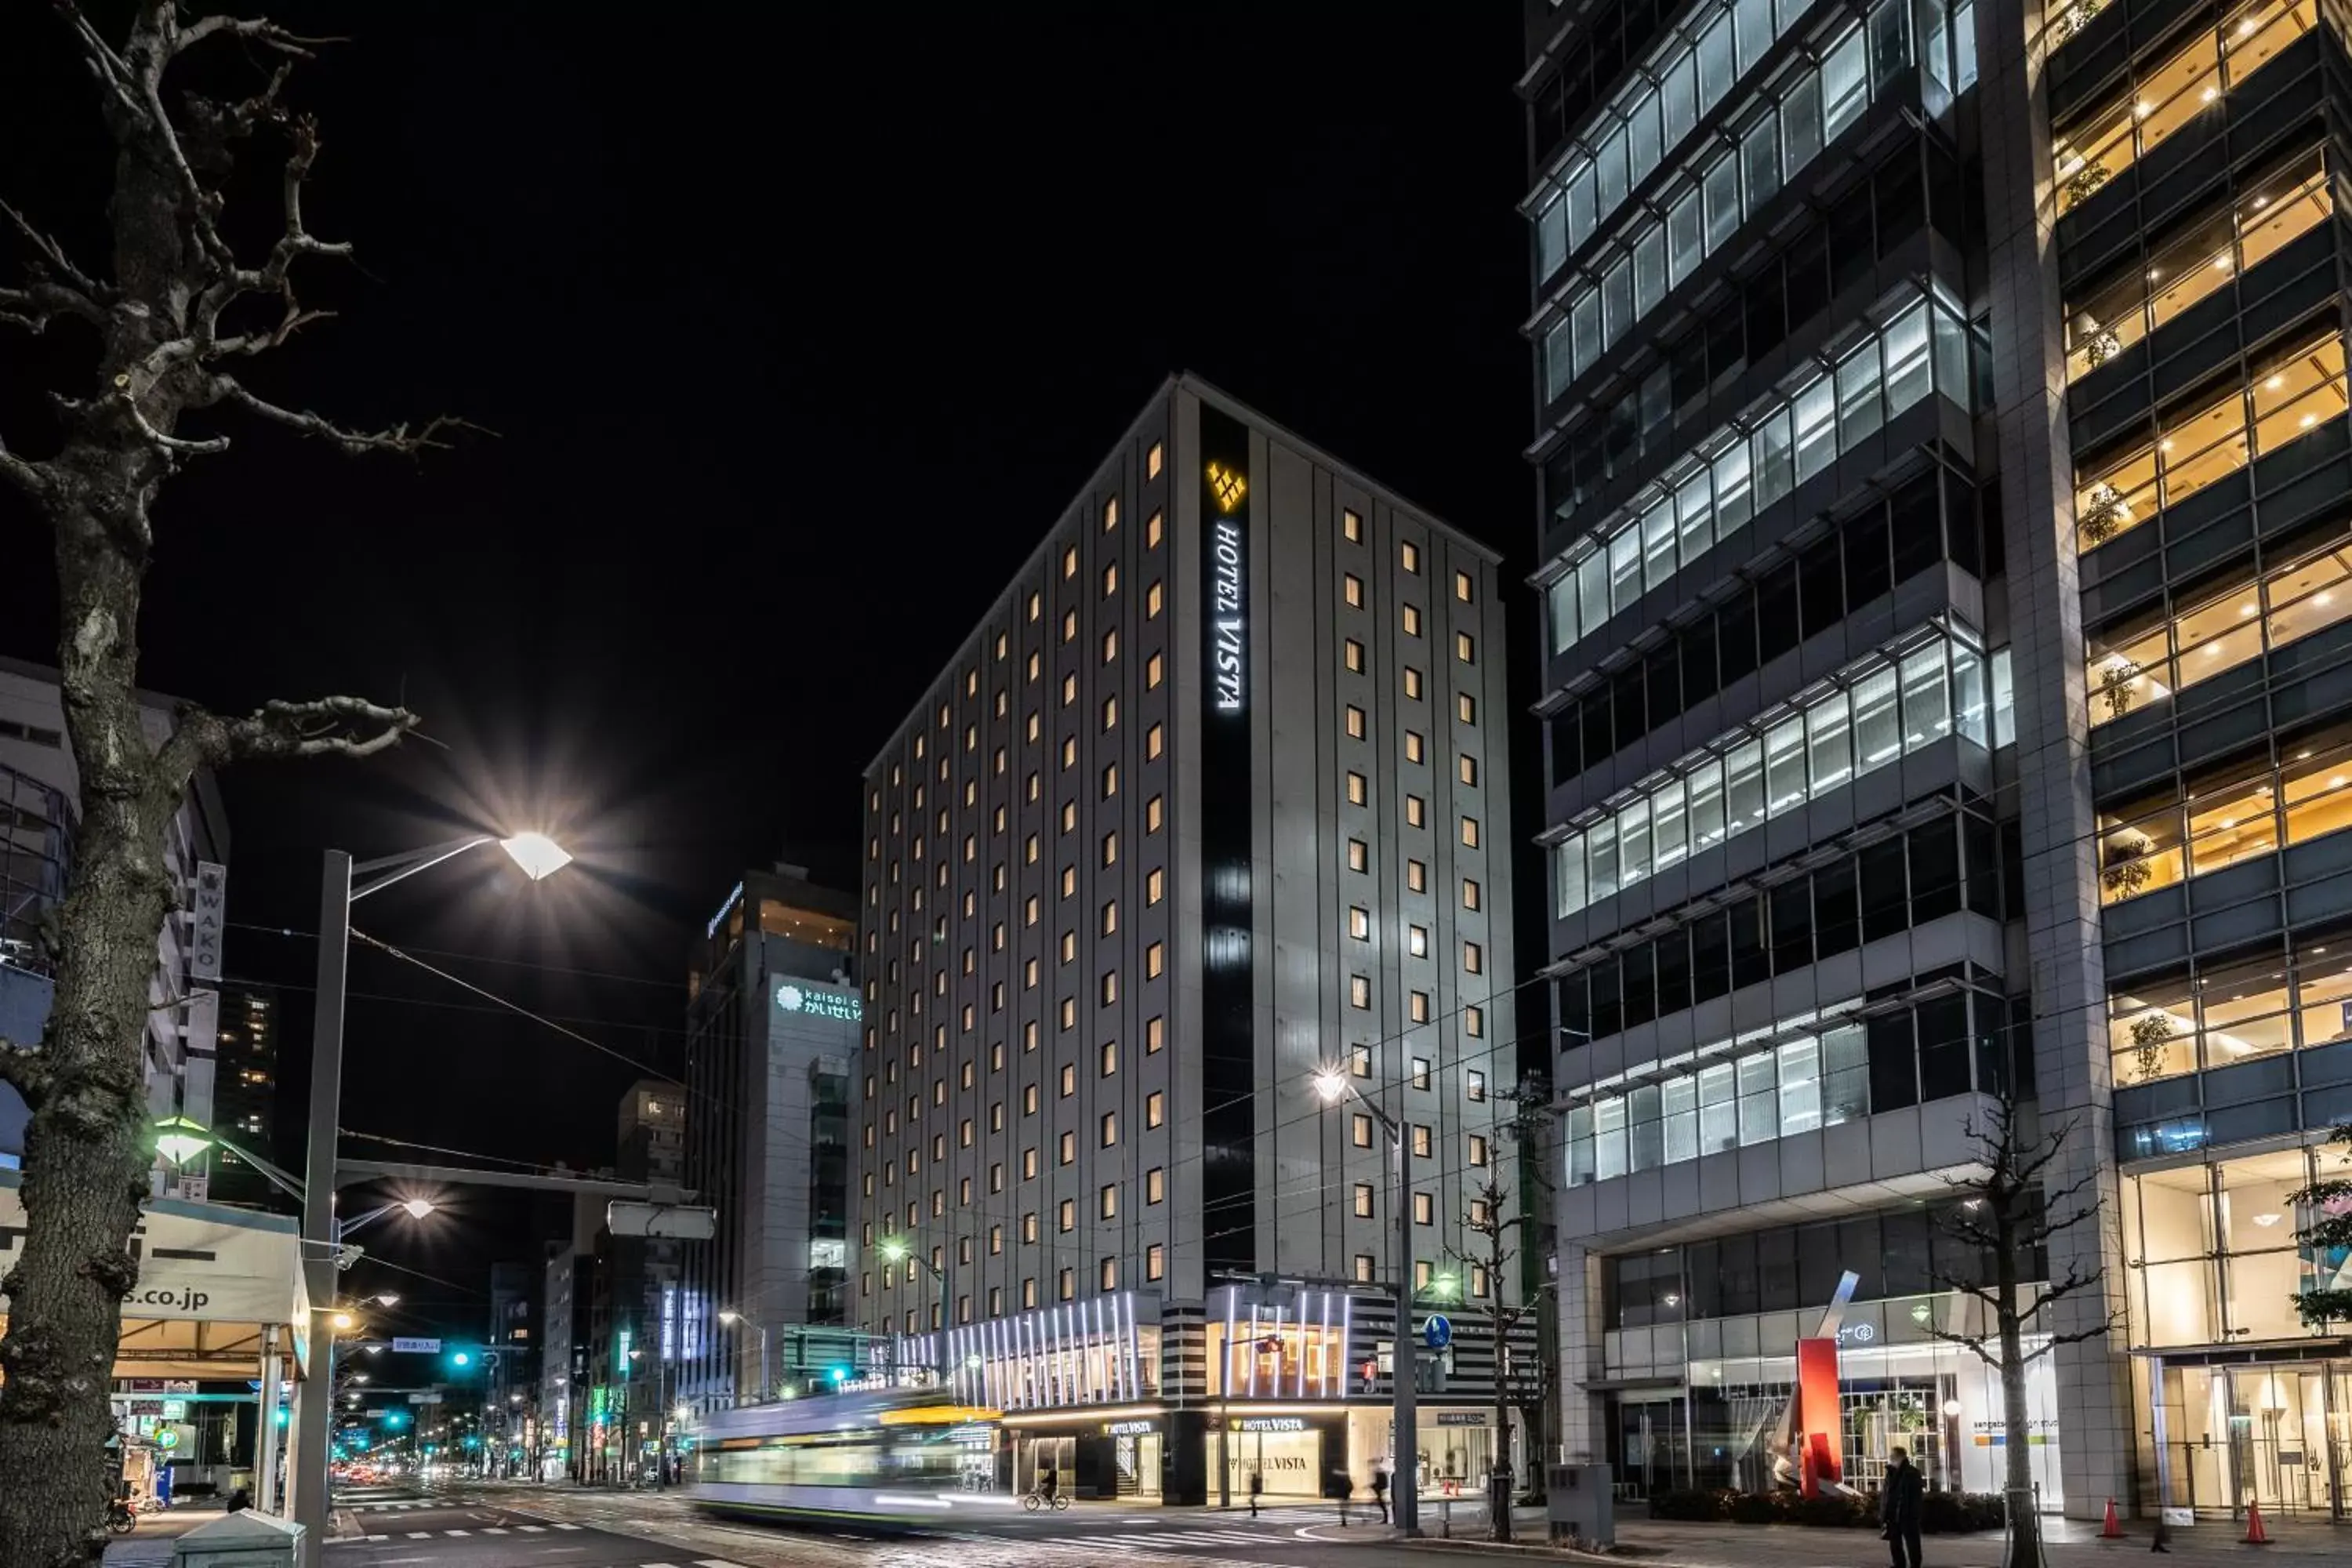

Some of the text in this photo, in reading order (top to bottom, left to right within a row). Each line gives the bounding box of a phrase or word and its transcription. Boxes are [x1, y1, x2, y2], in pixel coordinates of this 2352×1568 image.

[1217, 523, 1240, 709] HOTEL VISTA
[199, 895, 219, 966] WAKO
[1129, 1421, 1151, 1434] VISTA
[1243, 1417, 1304, 1431] HOTEL VISTA
[1273, 1457, 1306, 1470] VISTA
